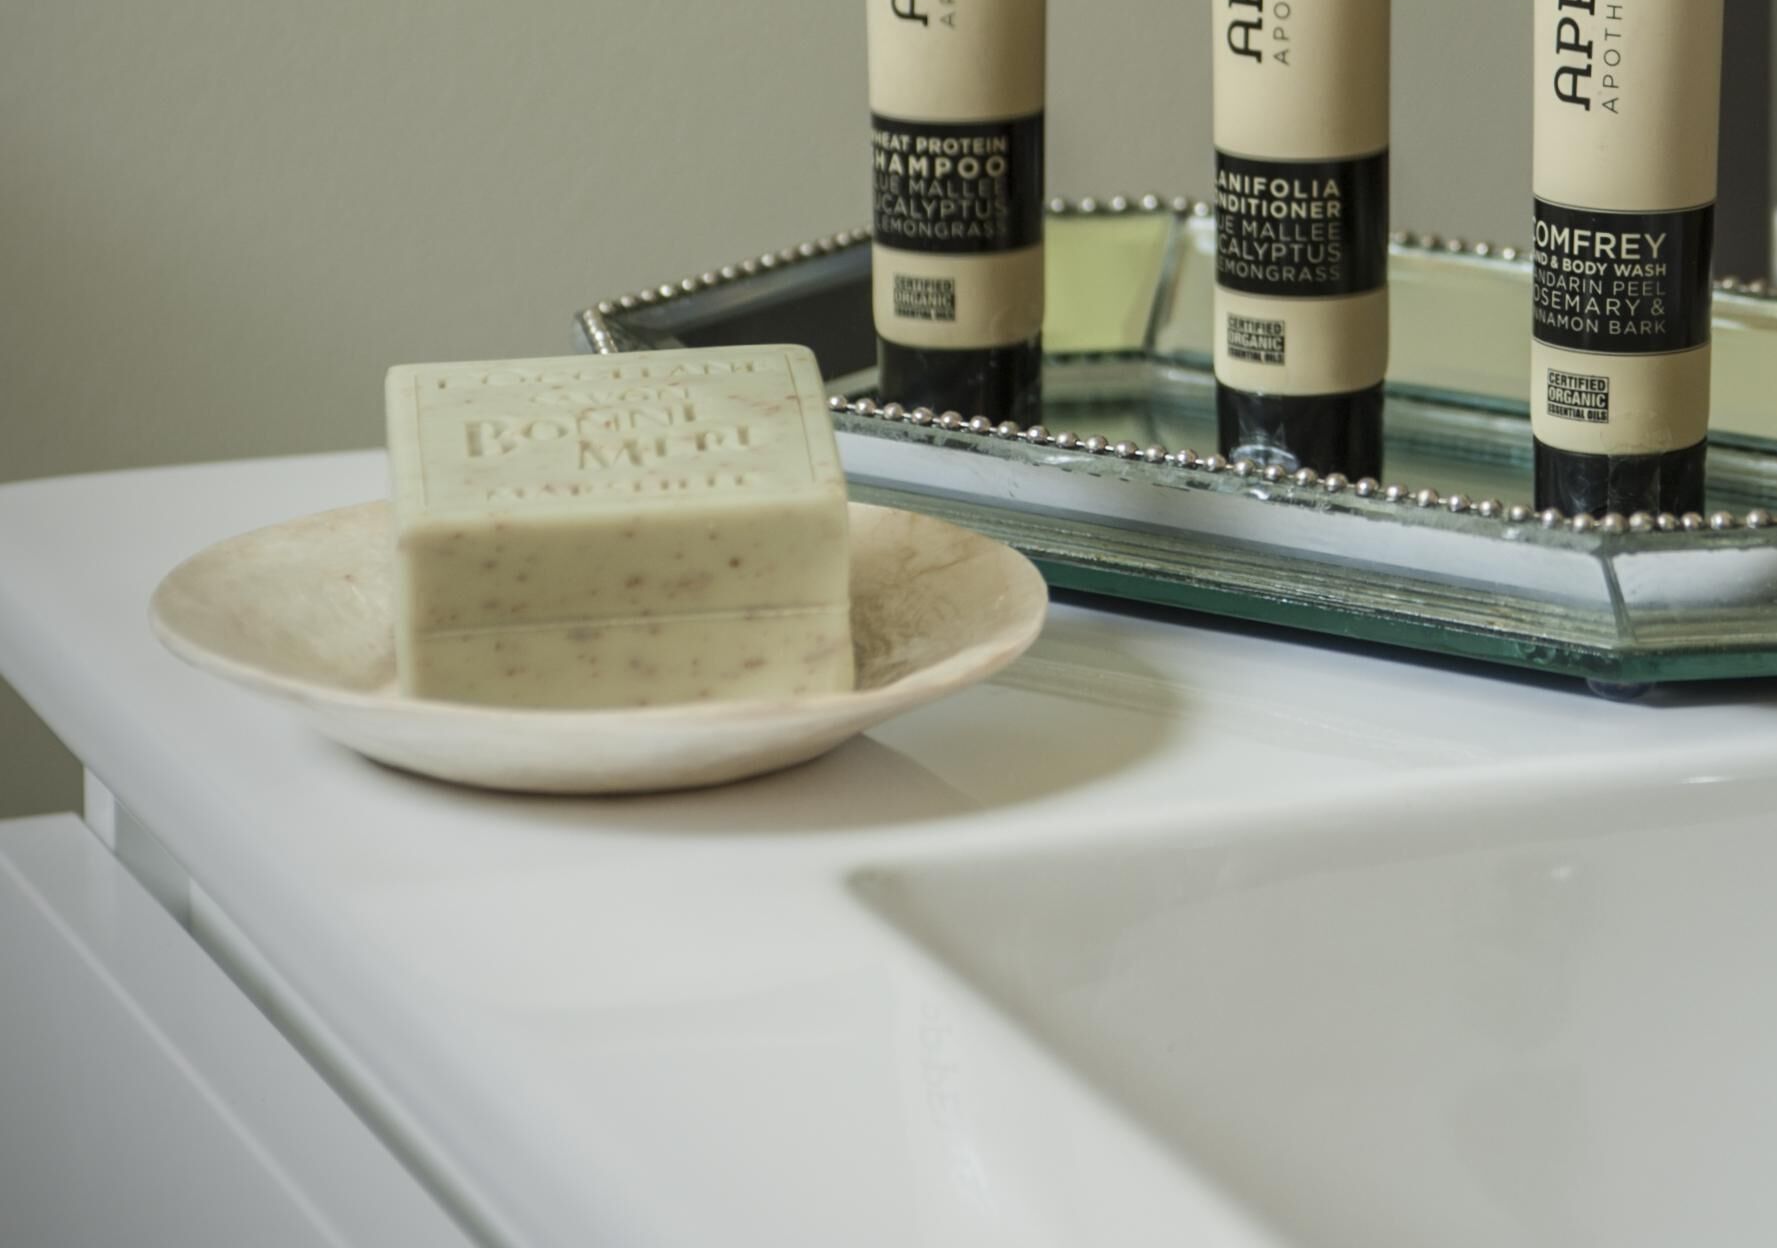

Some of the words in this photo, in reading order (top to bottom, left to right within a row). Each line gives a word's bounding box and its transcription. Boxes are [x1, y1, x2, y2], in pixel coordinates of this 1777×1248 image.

[872, 131, 909, 151] HEAT
[916, 136, 1008, 156] PROTEIN
[873, 149, 1008, 179] HAMPOO
[873, 173, 899, 191] UE
[874, 194, 1008, 220] UCALYPTUS
[1217, 193, 1341, 219] NDITIONER
[1242, 219, 1341, 241] MALLEE
[1217, 236, 1341, 263] CALYPTUS
[1217, 255, 1341, 282] EMONGRASS
[1550, 254, 1559, 269] &
[1562, 257, 1607, 277] BODY
[1613, 263, 1667, 277] WASH
[1533, 267, 1603, 296] ANDARIN
[1613, 281, 1666, 297] PEEL
[1533, 283, 1641, 317] OSEMARY
[1650, 298, 1665, 316] &
[1533, 305, 1600, 335] NNAMON
[1608, 320, 1667, 335] BARK
[1549, 371, 1606, 393] CERTIFIED
[1549, 387, 1606, 408] ORGANIC
